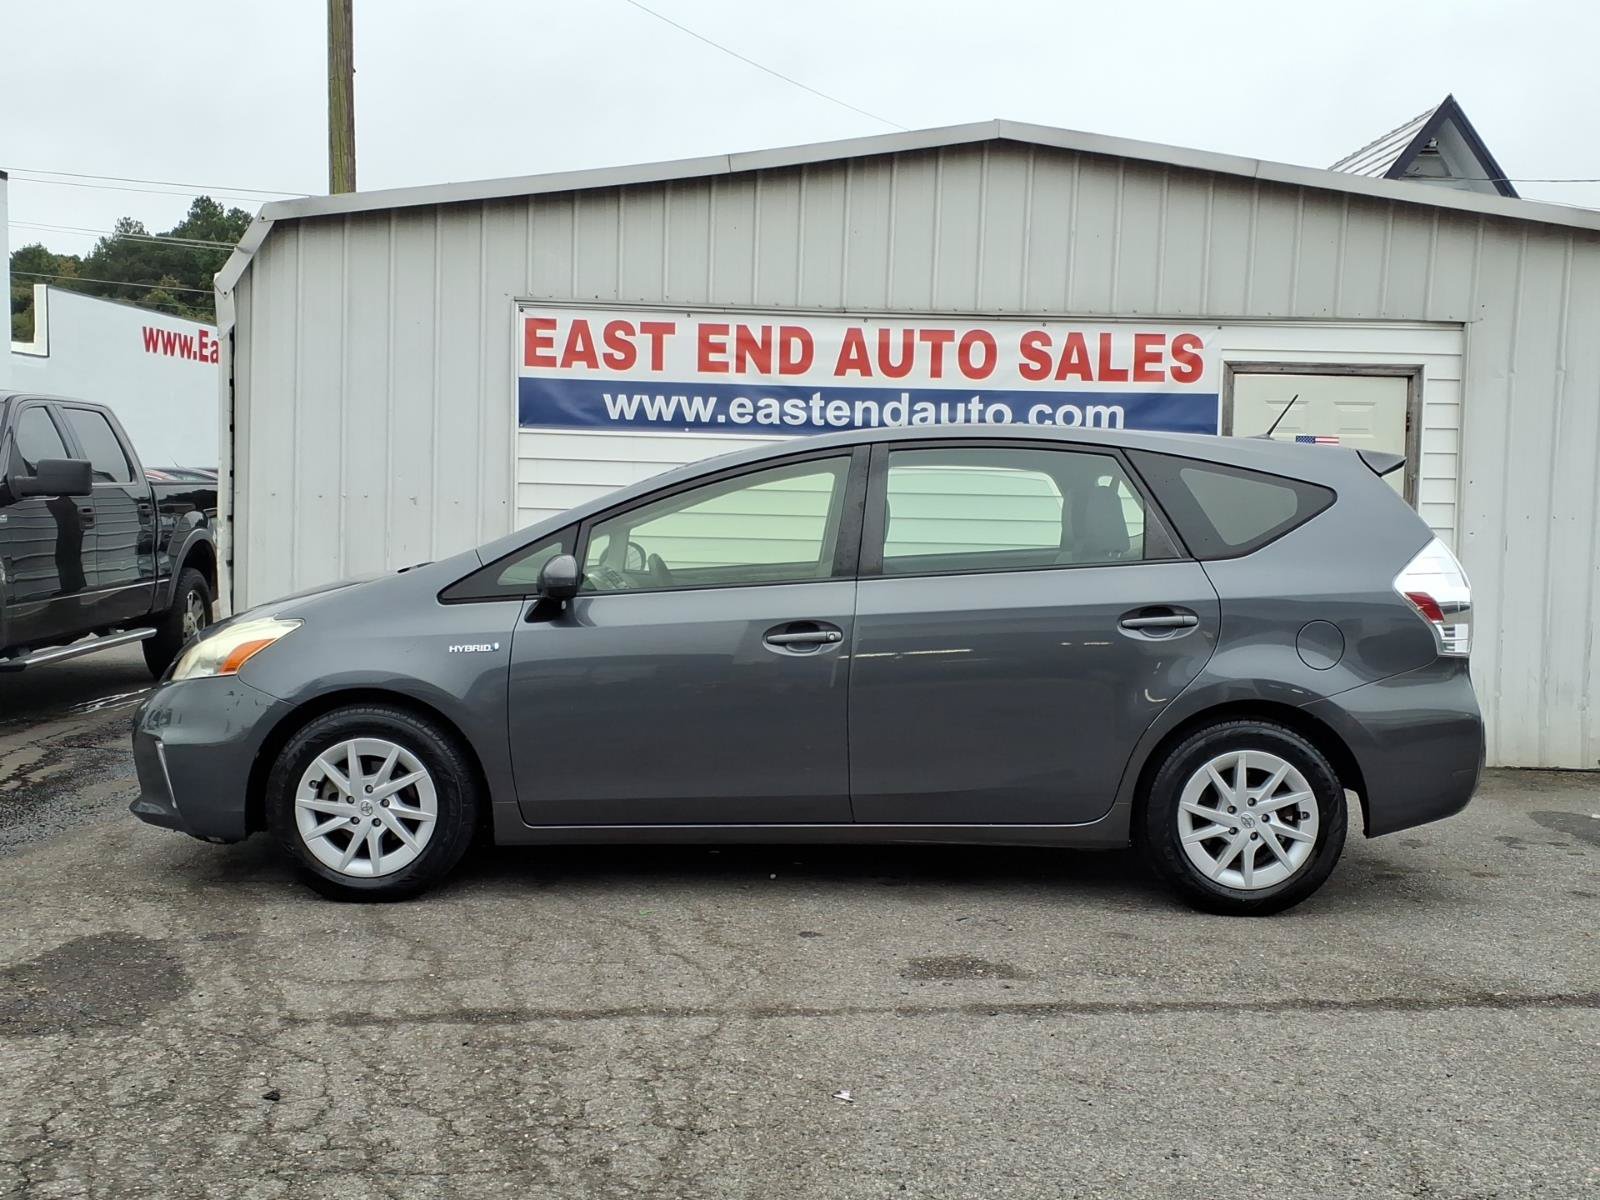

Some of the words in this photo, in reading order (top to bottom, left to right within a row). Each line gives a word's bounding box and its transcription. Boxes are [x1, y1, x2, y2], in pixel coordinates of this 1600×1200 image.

[524, 317, 675, 371] EAST
[697, 322, 814, 376] END
[833, 327, 998, 381] AUTO
[1018, 330, 1204, 384] SALES
[448, 643, 493, 653] HYBRID
